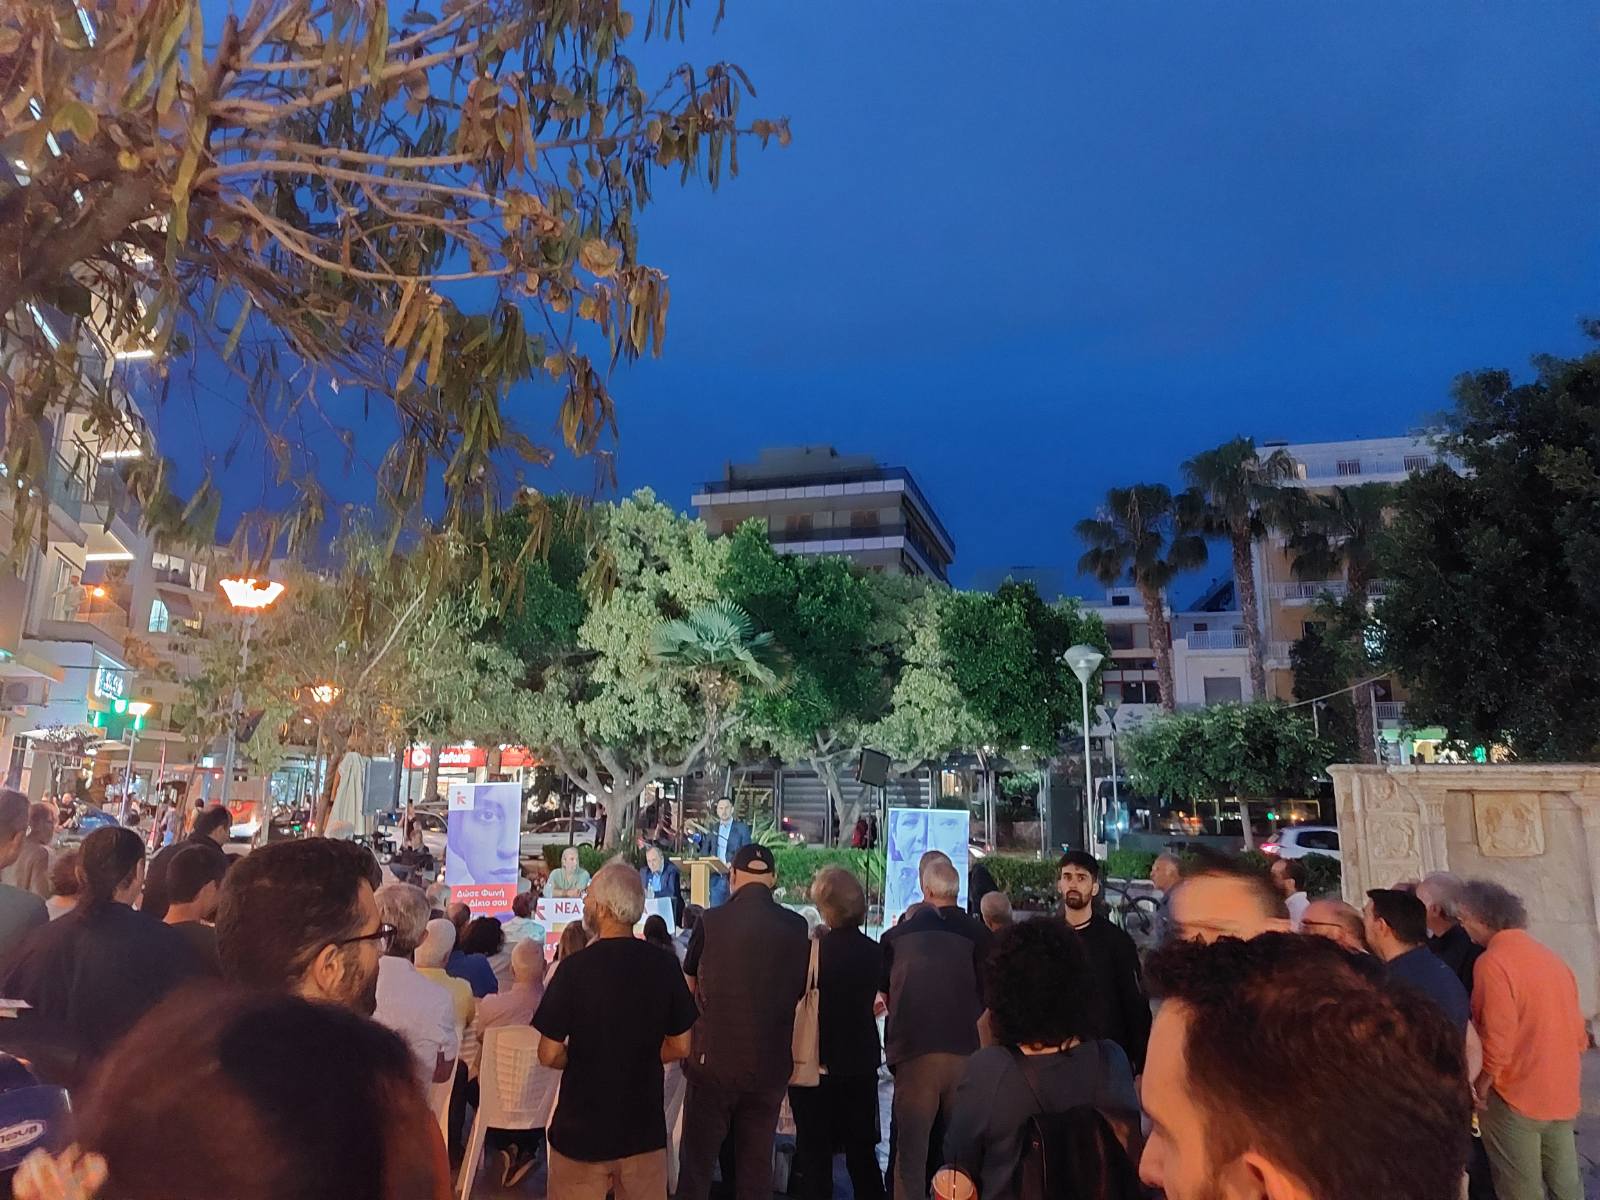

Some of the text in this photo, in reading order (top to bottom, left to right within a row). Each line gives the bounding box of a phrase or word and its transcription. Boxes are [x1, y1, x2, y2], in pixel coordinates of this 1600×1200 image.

[426, 751, 471, 764] vdafone
[456, 887, 505, 898] Δώσε Φωνή
[491, 899, 508, 907] σου
